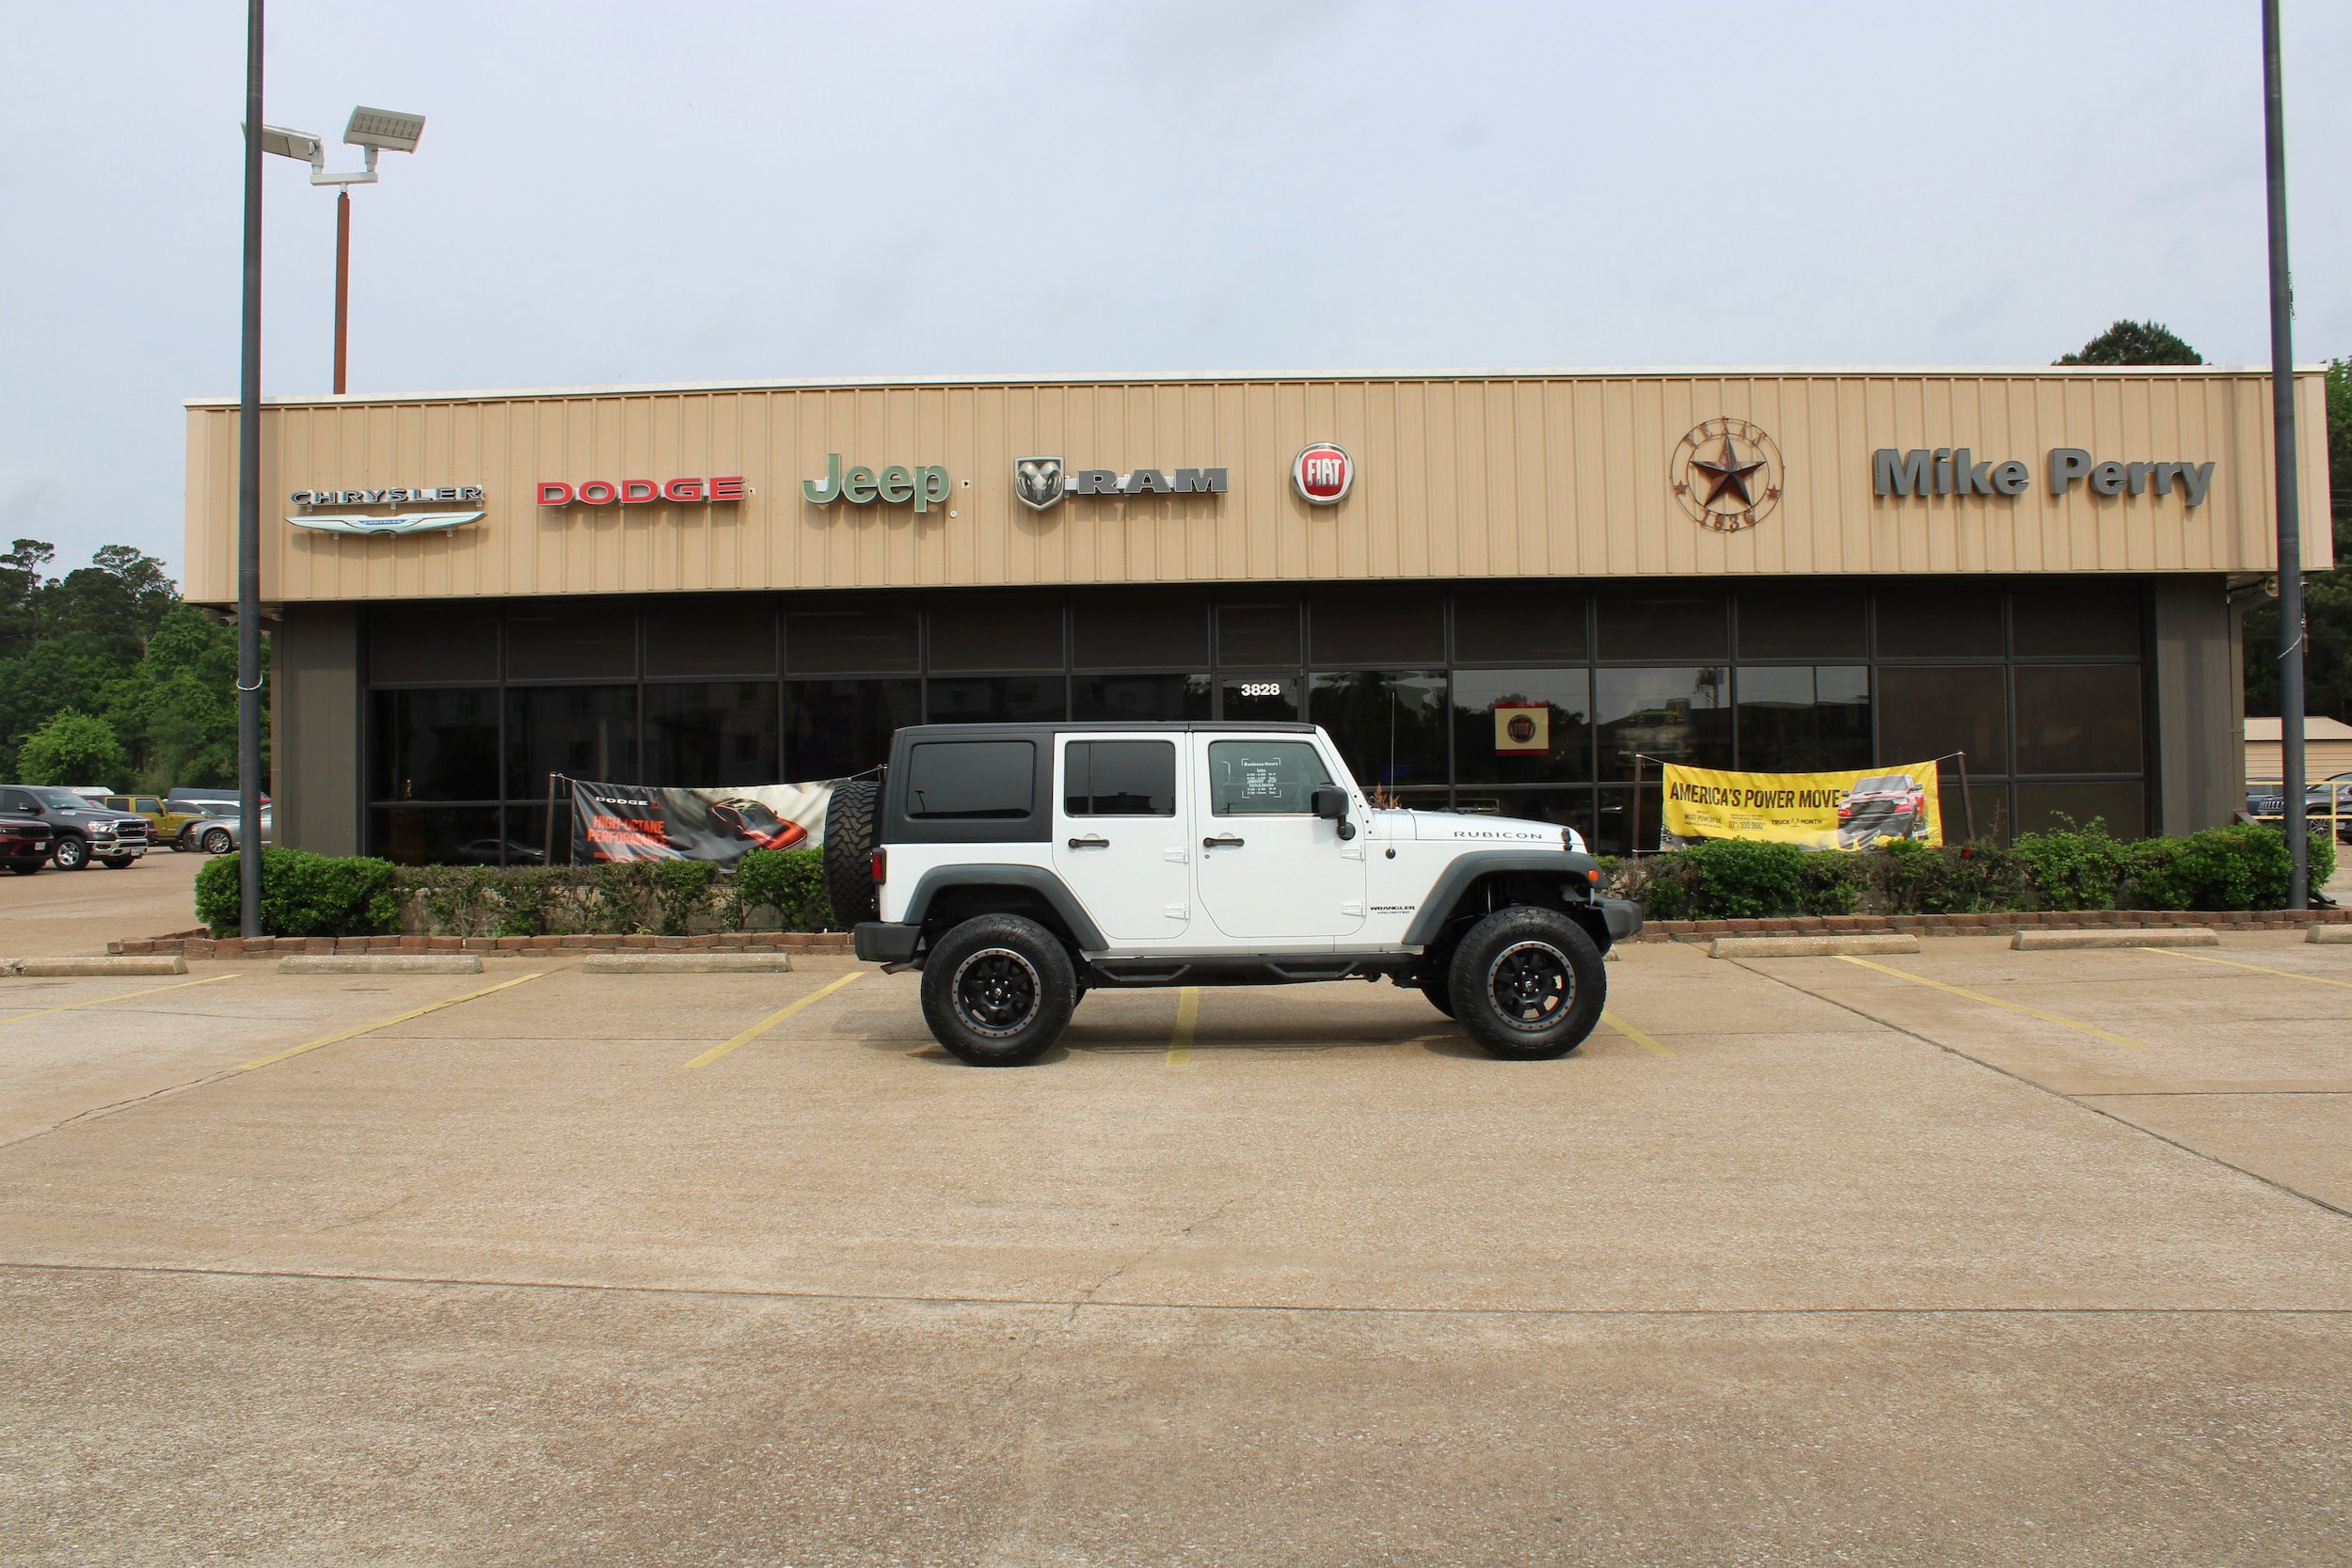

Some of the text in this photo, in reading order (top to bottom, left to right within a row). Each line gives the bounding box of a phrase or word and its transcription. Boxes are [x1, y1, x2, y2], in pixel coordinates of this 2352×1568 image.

[803, 453, 951, 513] Jeep
[1077, 468, 1229, 495] RAM
[1307, 458, 1343, 486] FIAT
[1873, 448, 2215, 509] Mike Perry
[291, 486, 483, 506] CHRYSLER
[537, 476, 745, 506] DODGE
[1699, 508, 1756, 533] 1836
[1241, 683, 1280, 696] 3828
[596, 796, 648, 806] DODGE
[1670, 782, 1840, 808] AMERICA'S POWER MOVE
[1454, 831, 1542, 839] RUBICON
